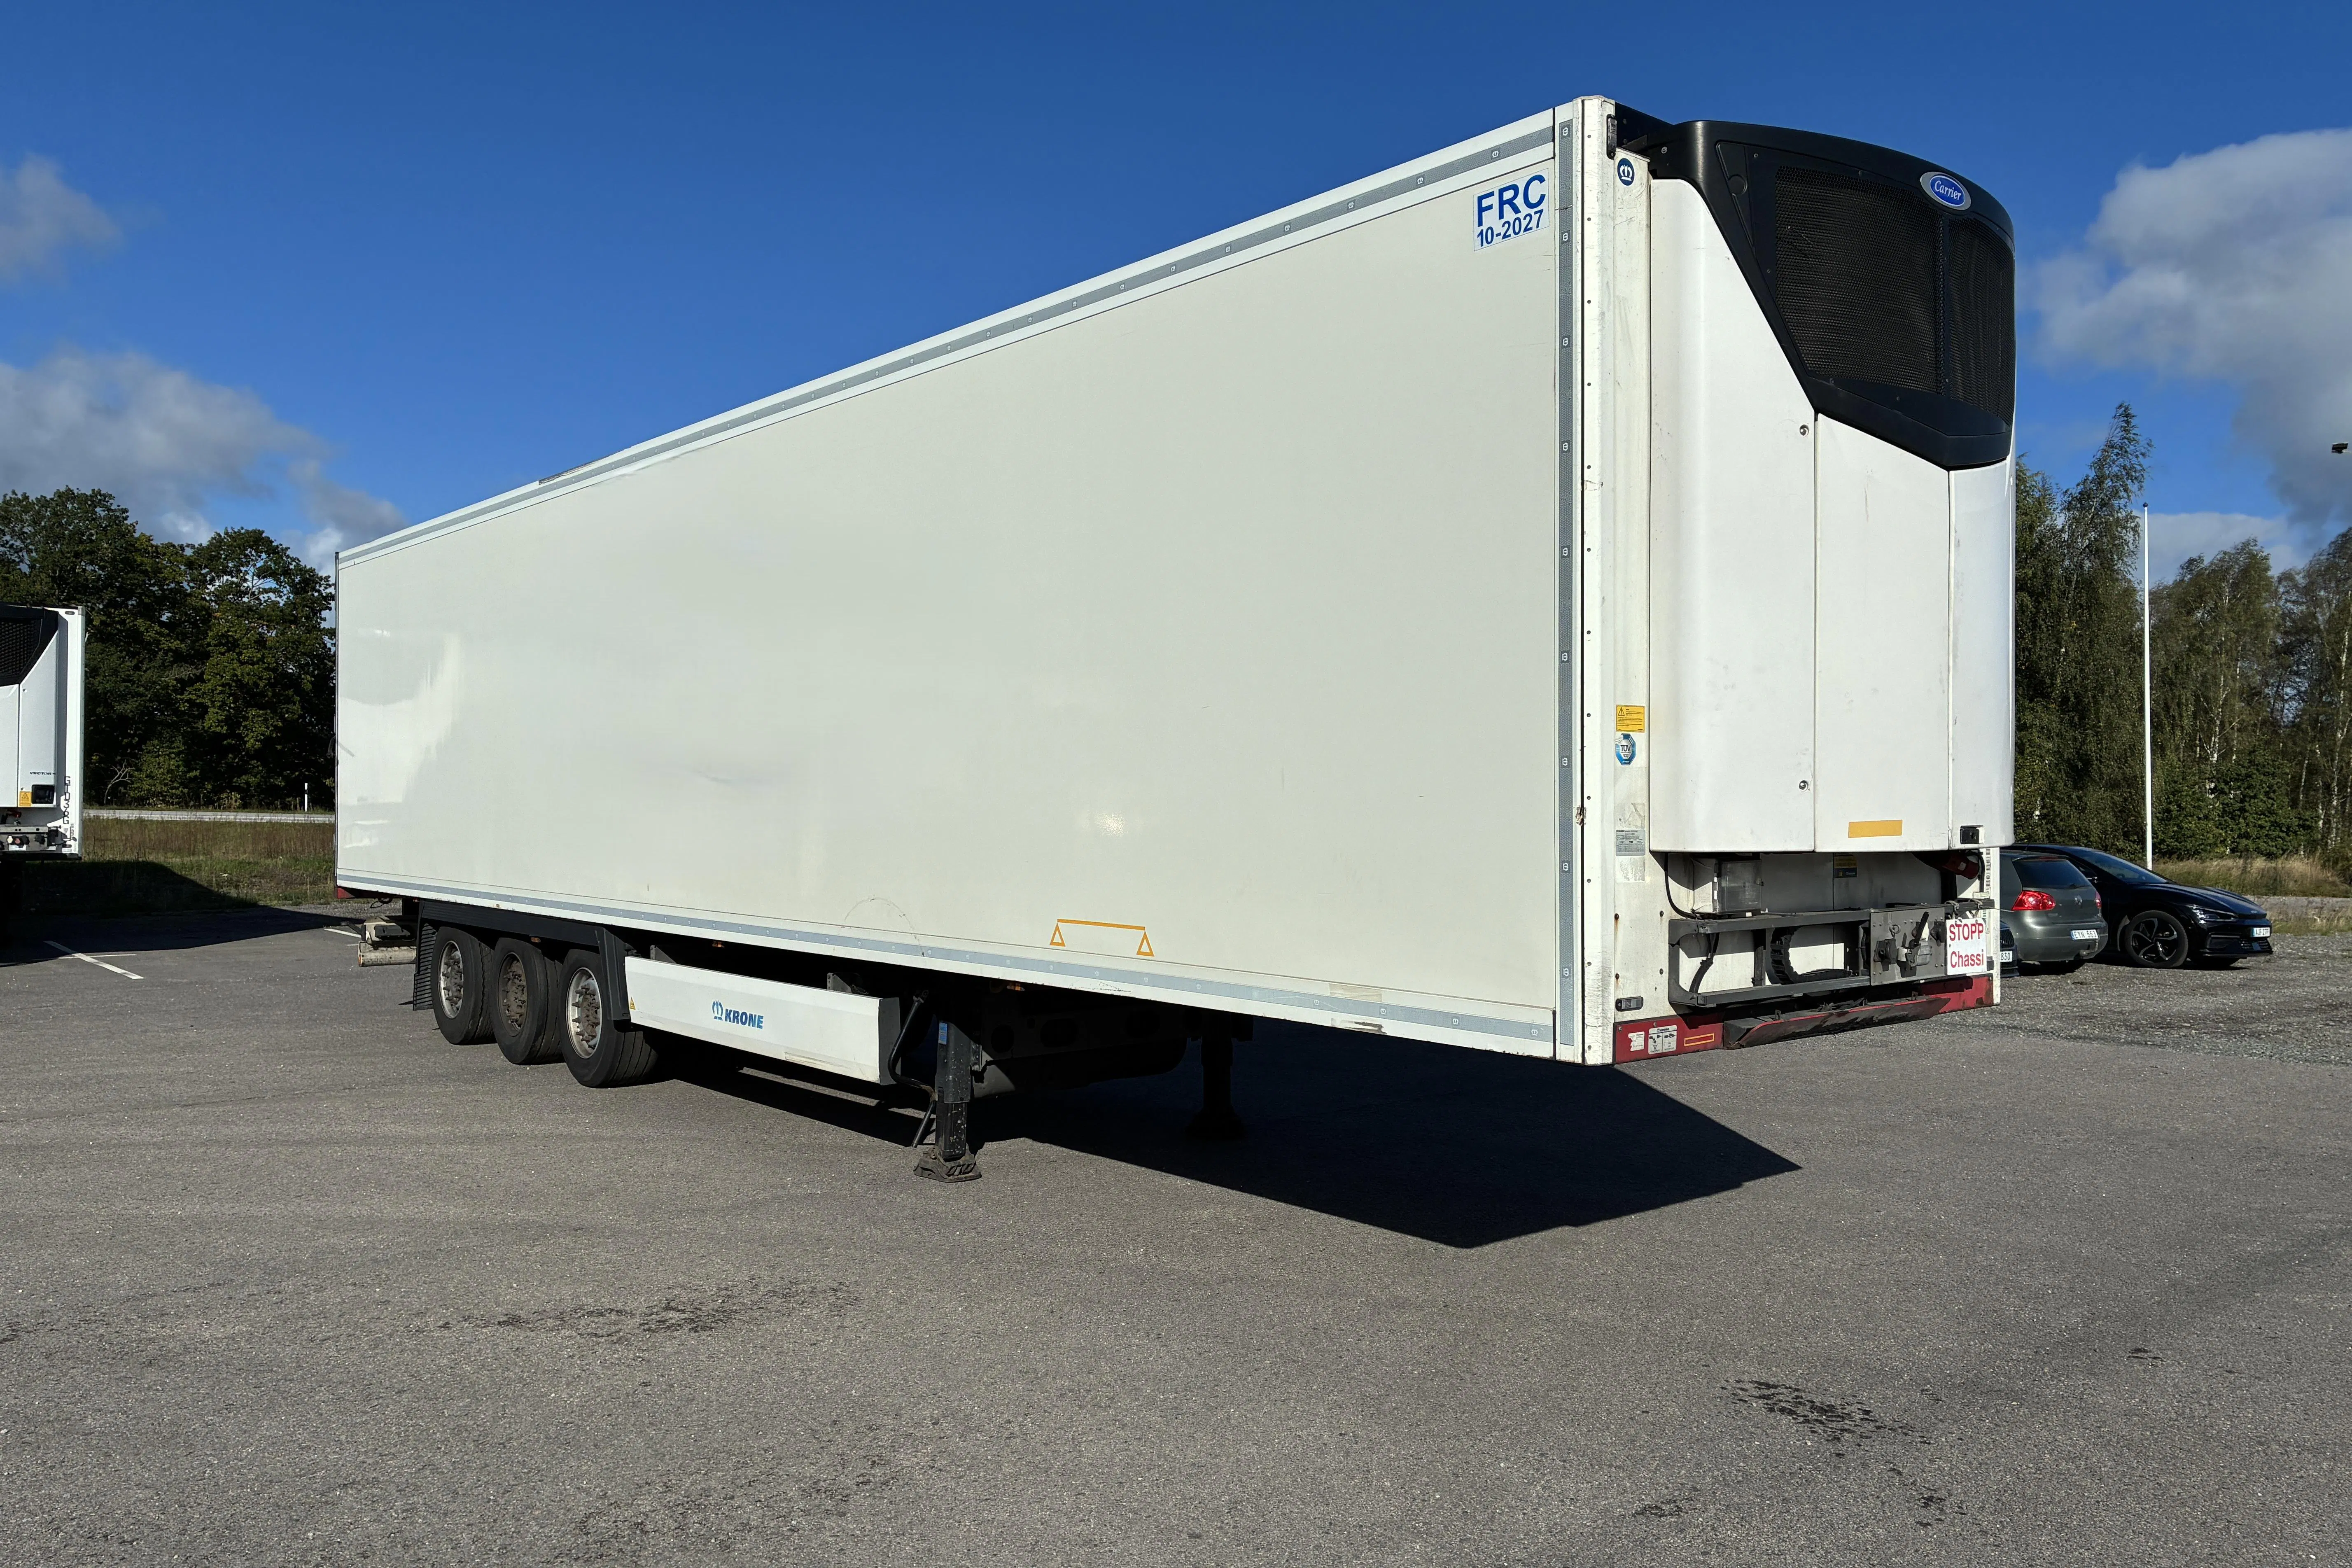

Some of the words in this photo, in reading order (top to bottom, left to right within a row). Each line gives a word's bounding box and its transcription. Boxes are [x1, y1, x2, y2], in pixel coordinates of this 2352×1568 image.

[1934, 180, 1962, 200] Carrier
[1477, 174, 1546, 228] FRC
[1477, 208, 1544, 247] 10-2027
[1949, 922, 1984, 941] STOPP
[1950, 948, 1984, 968] Chassi
[725, 1008, 764, 1030] KRONE
